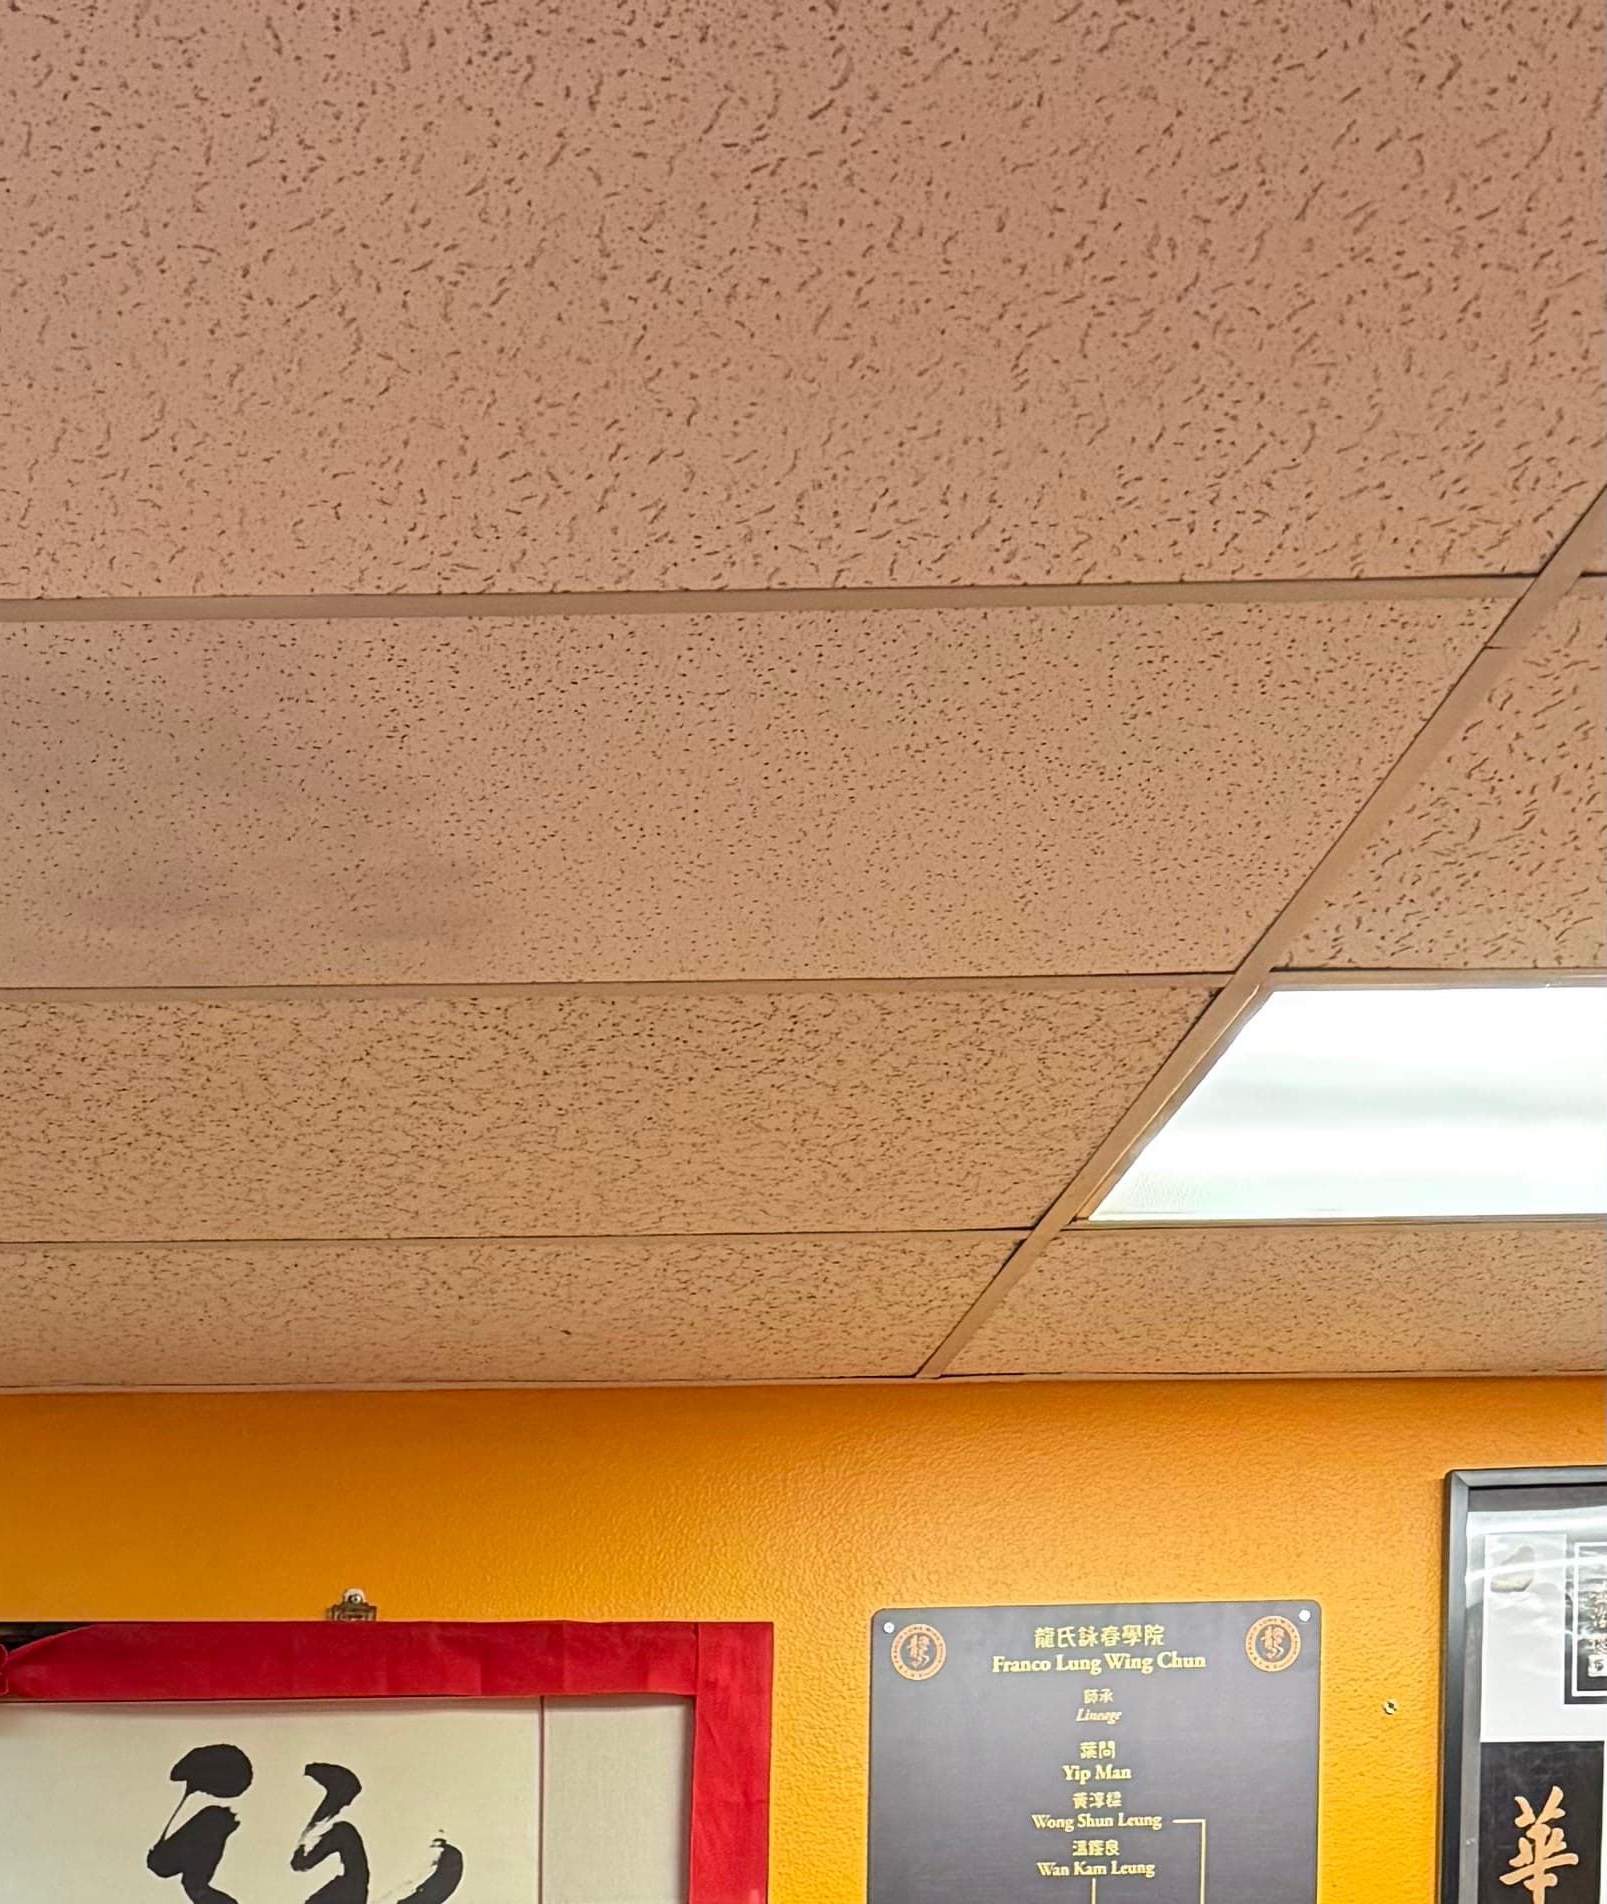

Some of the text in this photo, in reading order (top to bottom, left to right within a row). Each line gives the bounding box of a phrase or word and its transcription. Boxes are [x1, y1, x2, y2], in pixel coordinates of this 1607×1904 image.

[1034, 1624, 1165, 1649] 龍氏詠春學院
[992, 1651, 1206, 1675] Franco Lung Wing Chun
[1076, 1708, 1122, 1724] Lineage
[1080, 1741, 1116, 1760] 葉問
[1062, 1764, 1132, 1785] Yip Man
[1031, 1812, 1162, 1832] Wong Shun Leung
[1036, 1860, 1155, 1878] Wan Kam Leung
